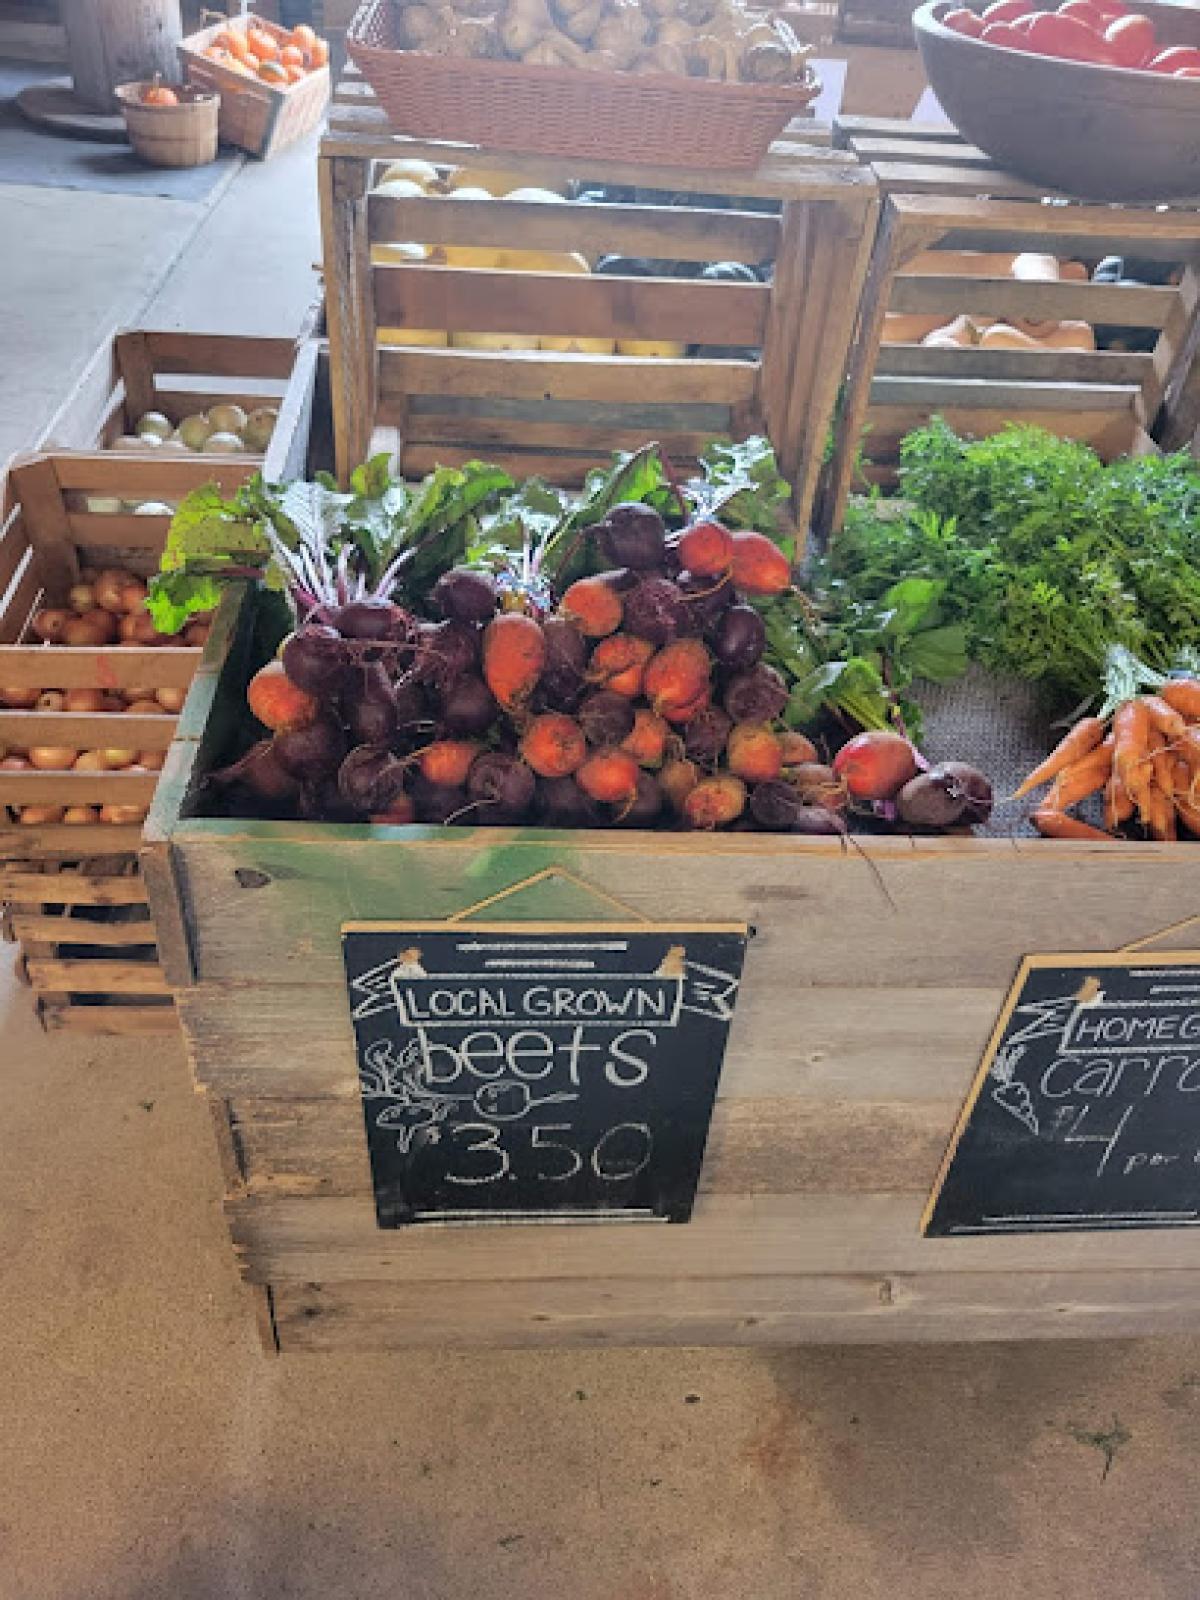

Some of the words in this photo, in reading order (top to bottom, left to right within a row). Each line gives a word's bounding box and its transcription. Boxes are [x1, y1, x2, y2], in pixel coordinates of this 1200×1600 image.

[407, 988, 515, 1017] LOCAL
[523, 987, 666, 1017] GROWN
[418, 1027, 657, 1086] beets
[445, 1123, 651, 1185] 3.50
